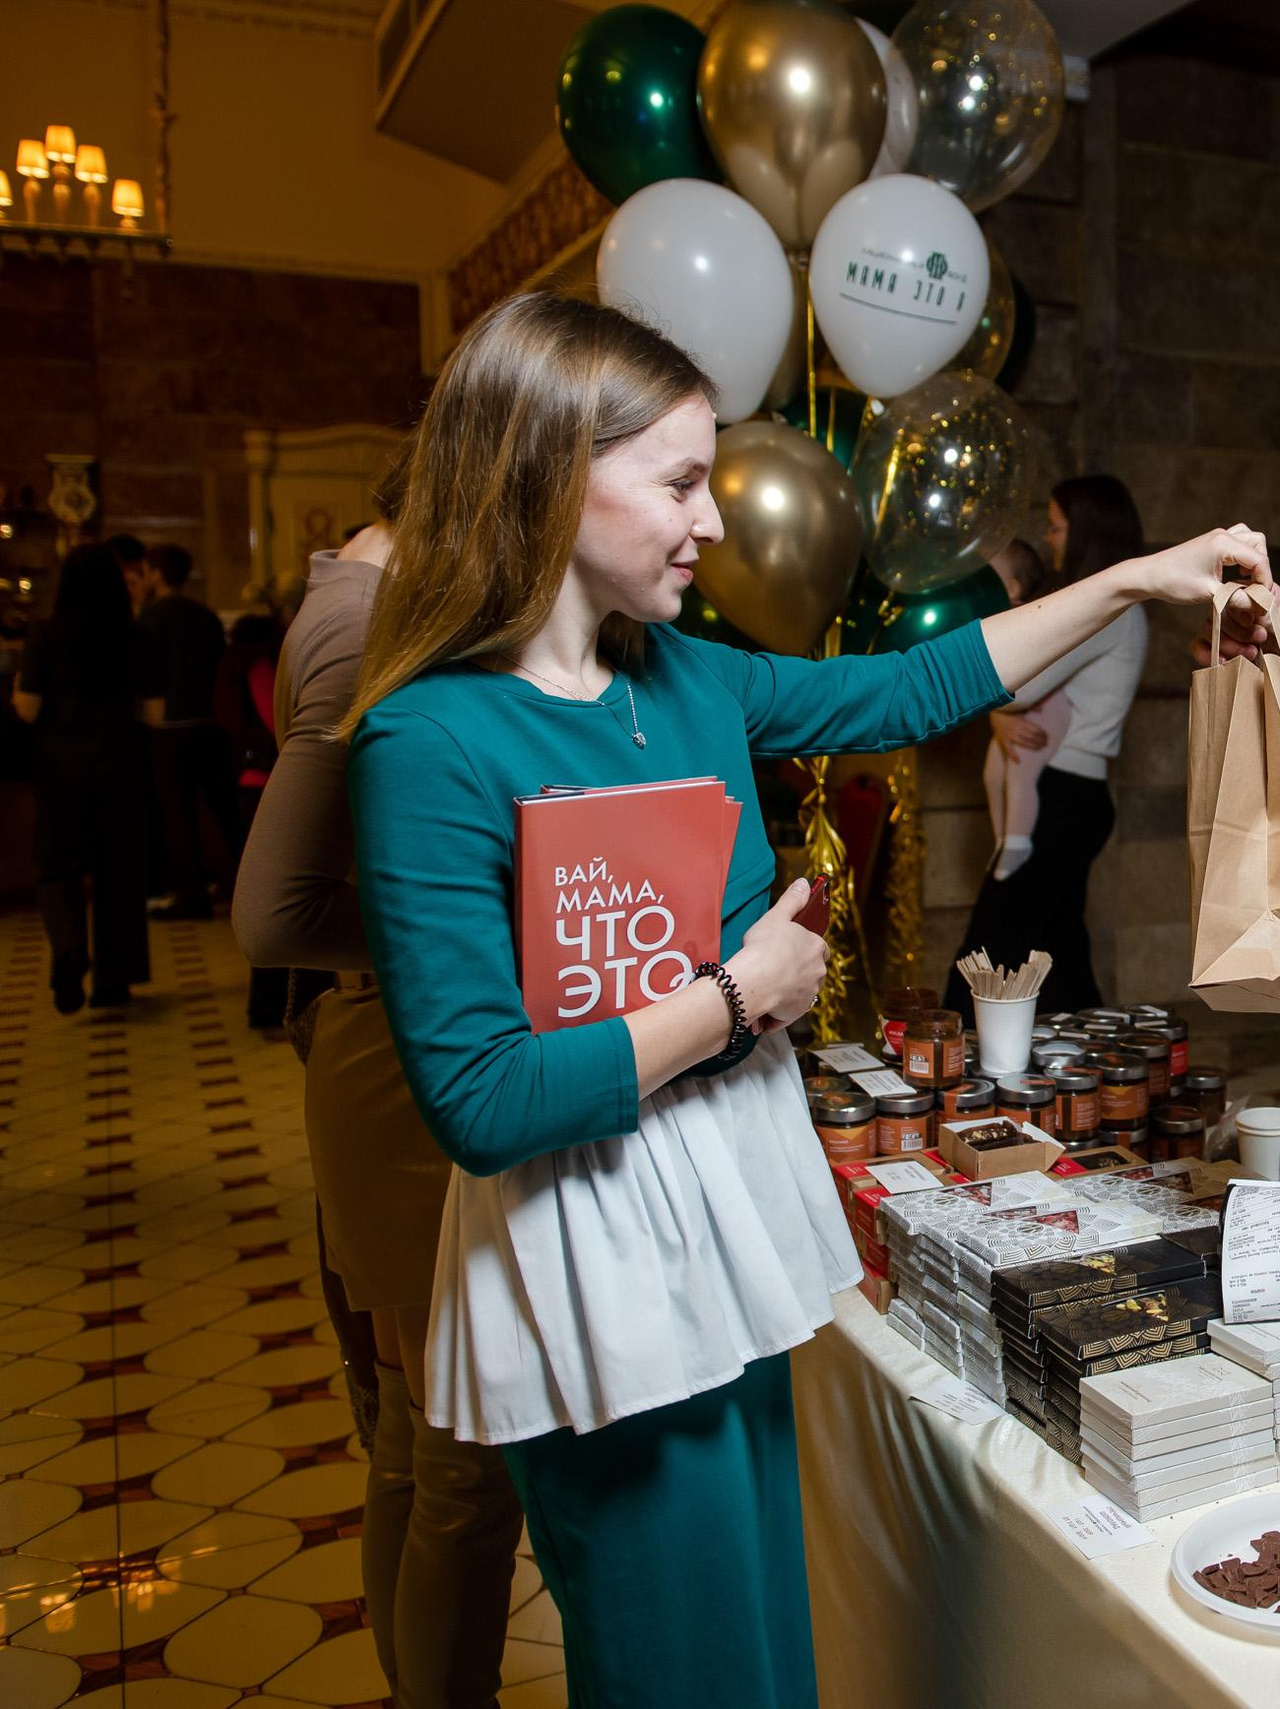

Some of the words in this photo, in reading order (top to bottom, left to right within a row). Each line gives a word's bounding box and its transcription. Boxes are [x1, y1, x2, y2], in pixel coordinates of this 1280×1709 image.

[554, 856, 614, 886] ВАЙ,
[555, 879, 665, 914] МАМА,
[555, 905, 675, 962] ЧТО
[557, 950, 693, 1018] ЭТО
